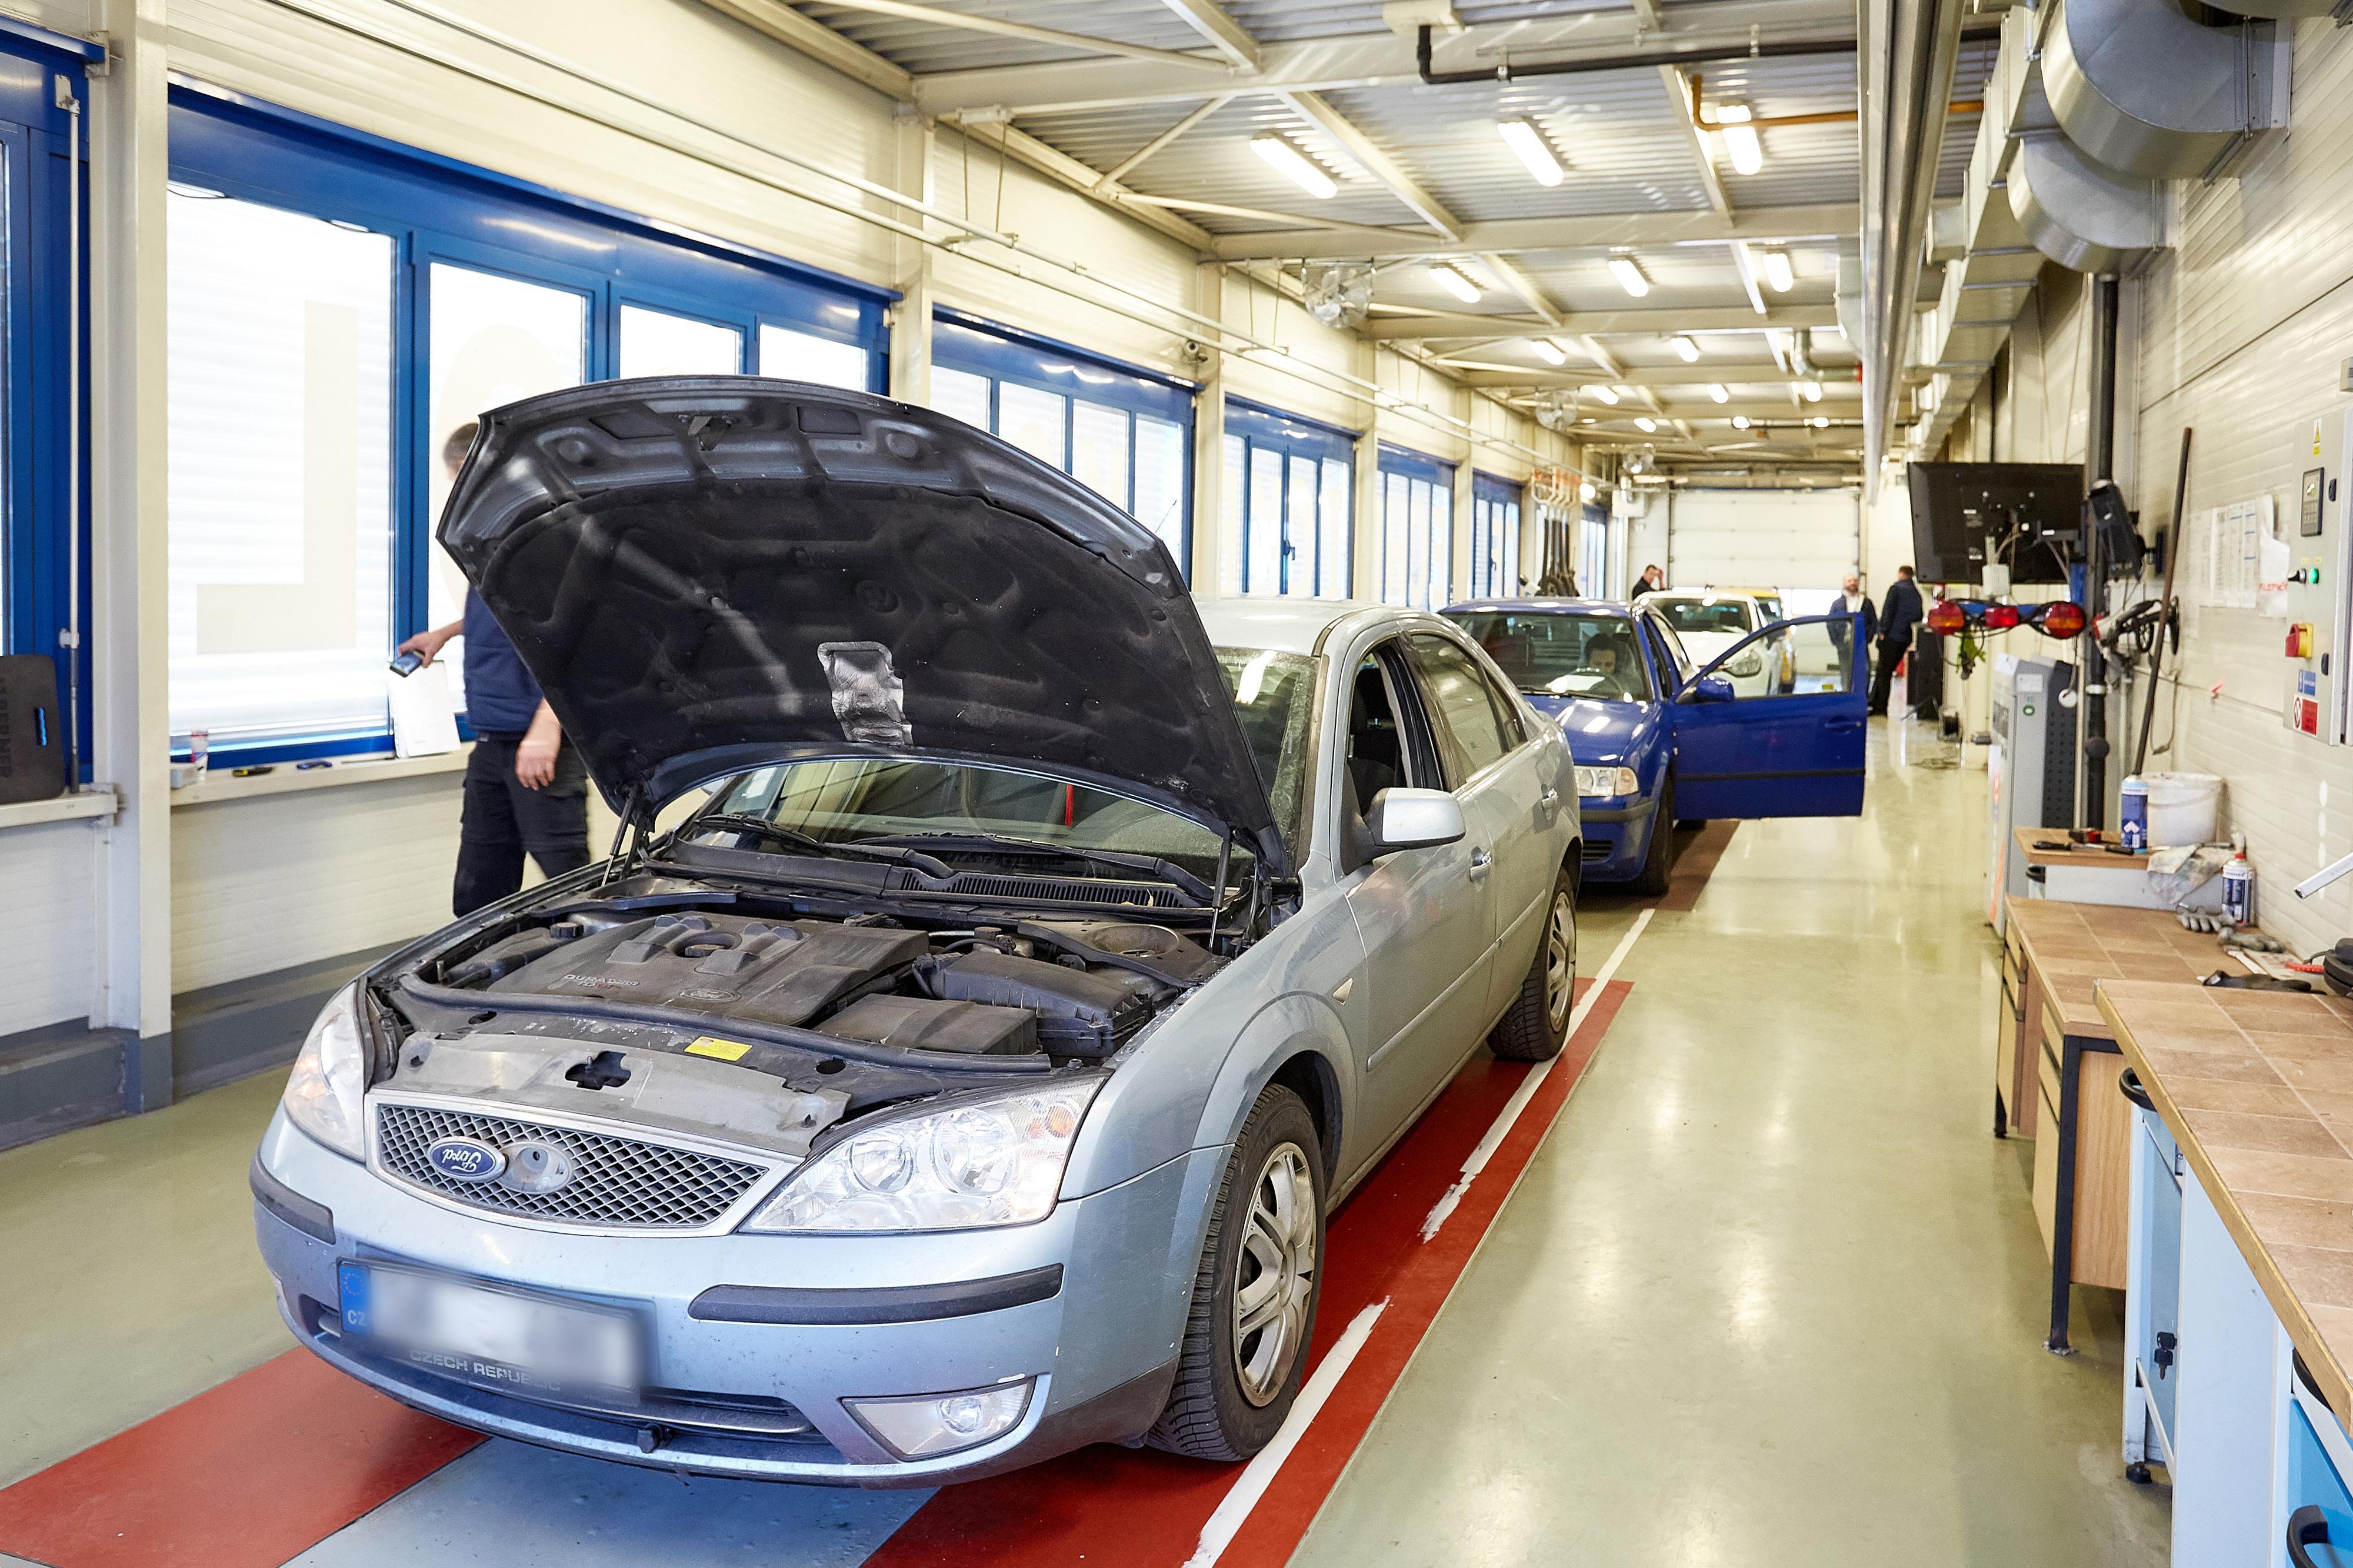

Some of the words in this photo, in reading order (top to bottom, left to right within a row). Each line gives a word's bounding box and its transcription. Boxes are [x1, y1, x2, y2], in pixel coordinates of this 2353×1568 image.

[442, 1148, 482, 1173] Ford
[347, 1309, 368, 1327] CZ
[409, 1349, 468, 1372] CZECH
[473, 1362, 561, 1392] REPUBLIC
